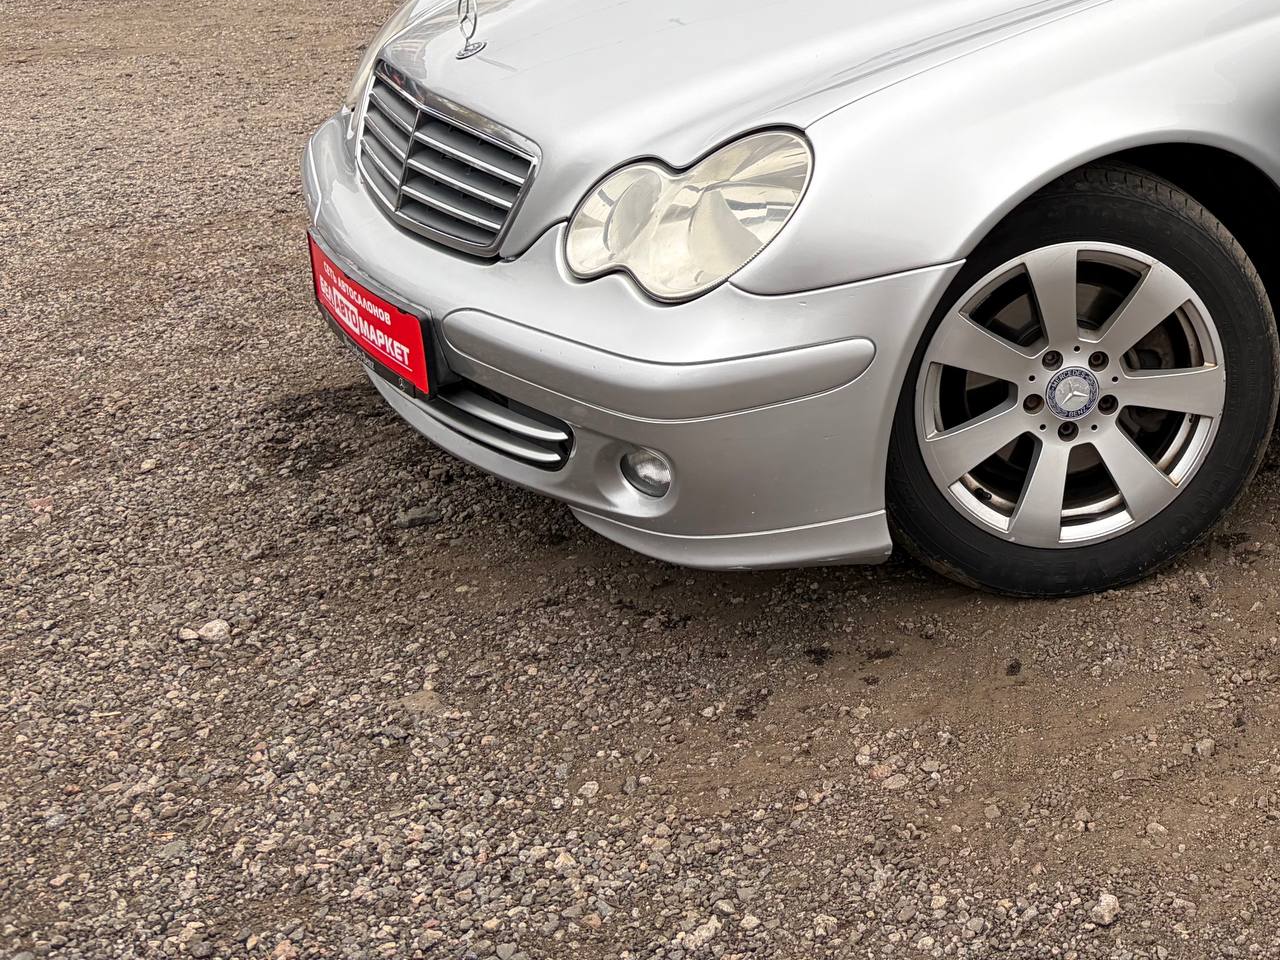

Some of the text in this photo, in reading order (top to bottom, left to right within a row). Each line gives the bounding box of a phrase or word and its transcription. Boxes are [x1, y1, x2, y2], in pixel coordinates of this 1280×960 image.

[323, 261, 391, 325] СЕТЬ АВТОСАЛОНОВ
[320, 275, 335, 305] БЕЛ
[360, 317, 409, 366] МАРКЕТ
[1051, 369, 1087, 387] MERCEDES
[1068, 406, 1088, 417] BENZ
